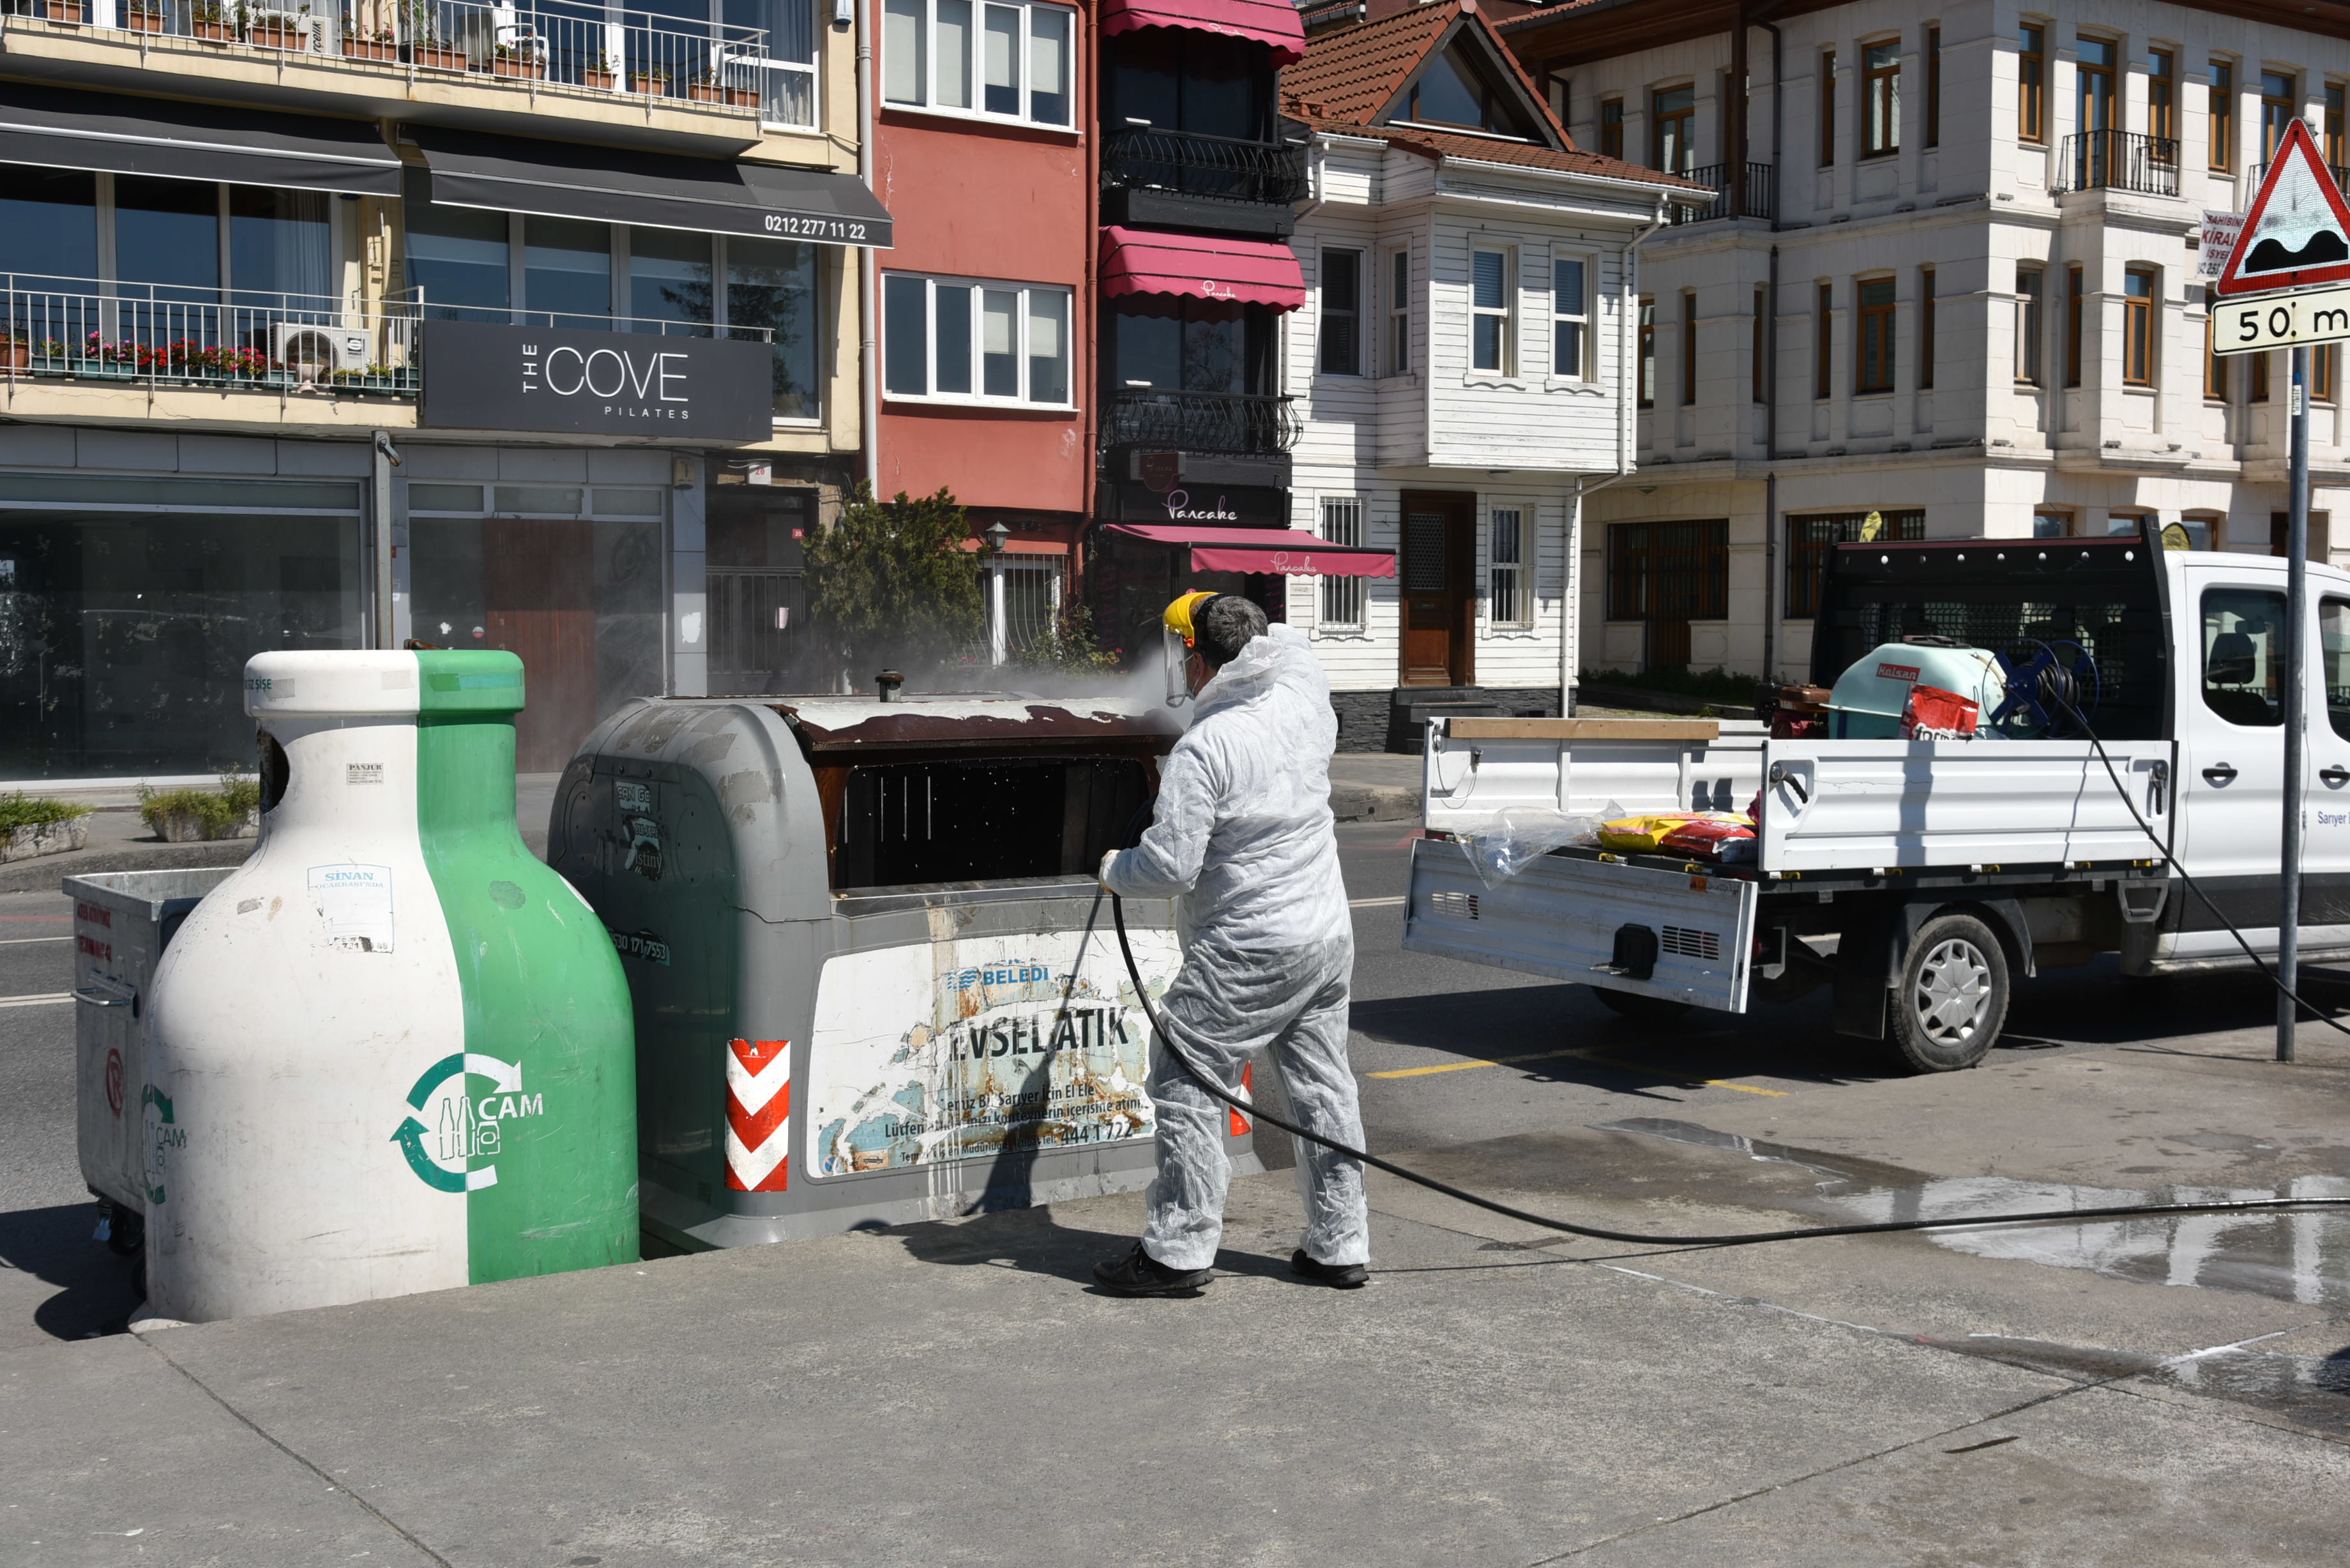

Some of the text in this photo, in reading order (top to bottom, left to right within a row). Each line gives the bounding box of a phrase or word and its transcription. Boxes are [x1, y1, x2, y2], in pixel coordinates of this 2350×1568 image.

[765, 215, 866, 240] 0212 277 11 22
[2239, 306, 2348, 342] 50 m
[522, 344, 538, 393] THE
[546, 347, 689, 402] COVE
[604, 406, 689, 419] PILATES
[1161, 489, 1238, 520] Pancake
[1270, 551, 1317, 572] Pancake
[255, 676, 272, 693] ŞİŞE
[630, 937, 644, 954] 171
[646, 940, 666, 960] 7553
[1055, 1006, 1128, 1050] ATIK
[1065, 1083, 1075, 1099] El
[1078, 1082, 1095, 1097] Ele
[478, 1093, 544, 1120] CAM
[1061, 1124, 1089, 1145] 444
[1093, 1122, 1100, 1141] 1
[1106, 1120, 1133, 1141] 722
